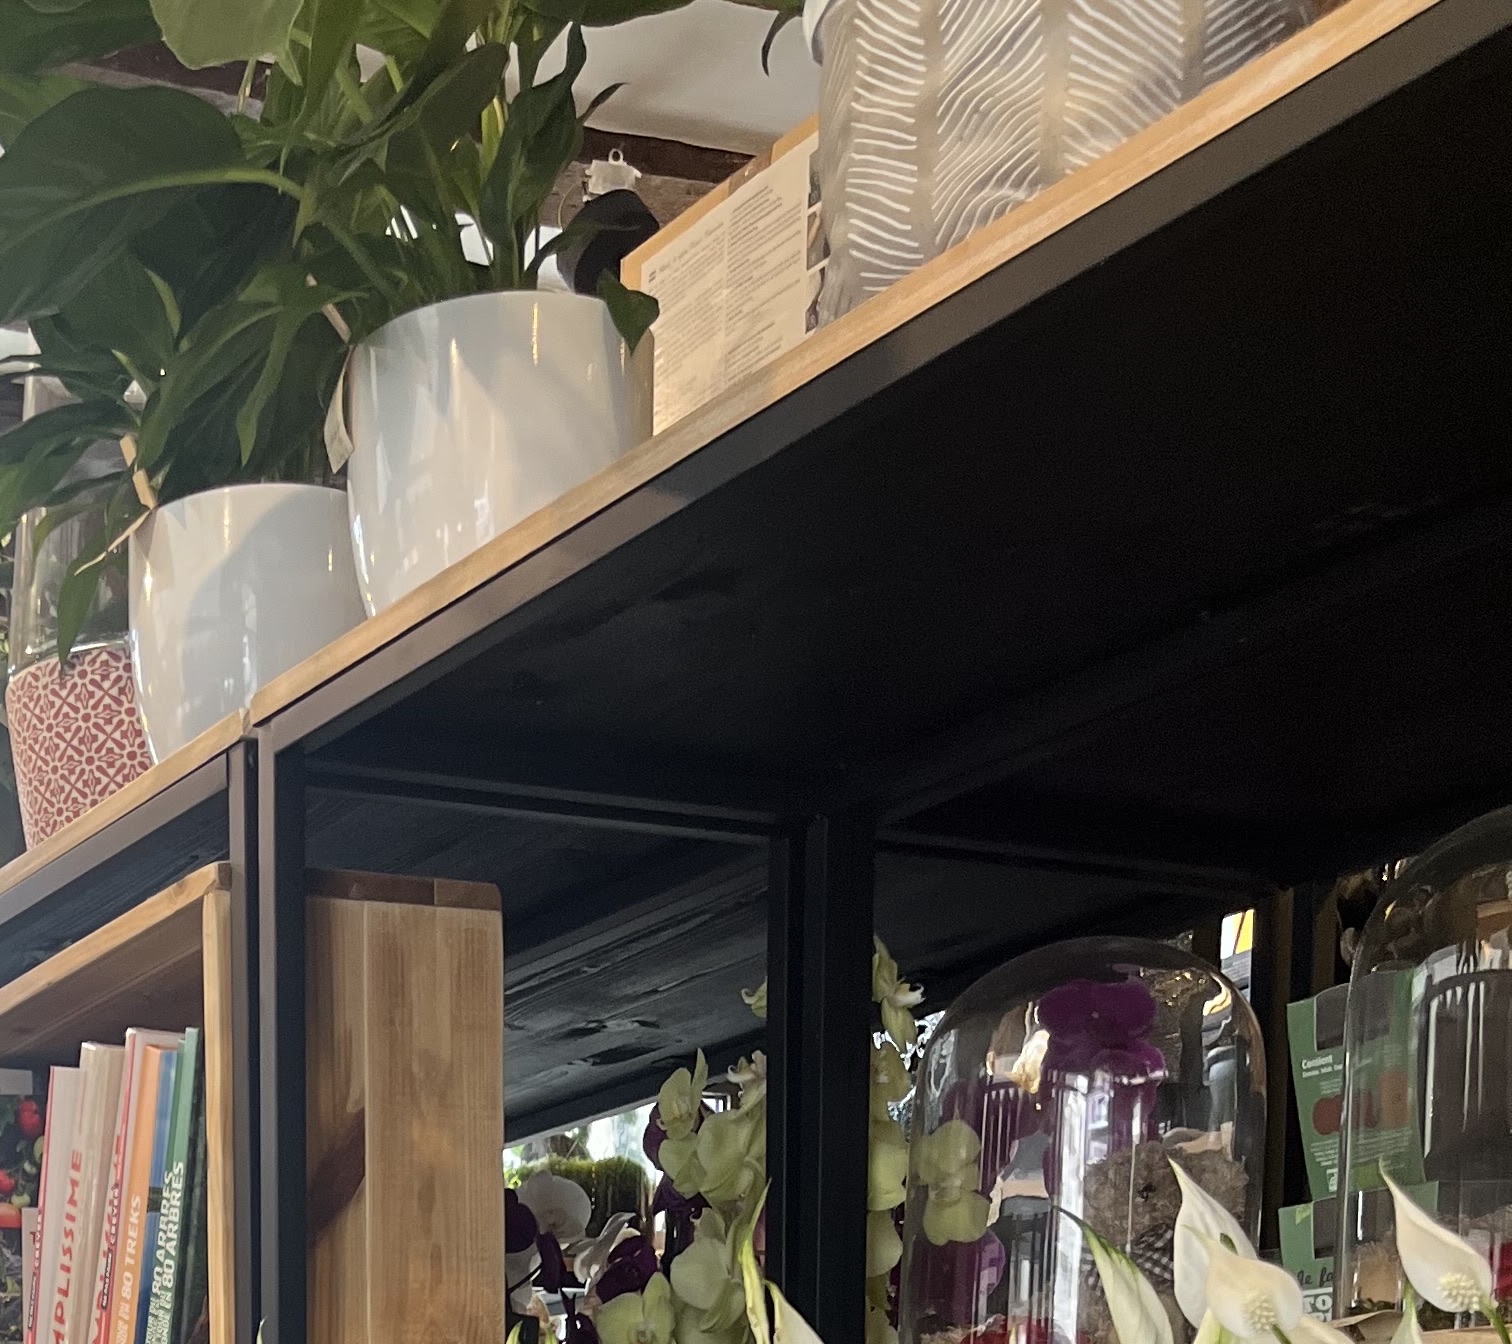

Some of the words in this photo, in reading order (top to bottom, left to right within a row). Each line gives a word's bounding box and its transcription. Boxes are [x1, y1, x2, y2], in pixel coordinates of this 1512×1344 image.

[1301, 1054, 1334, 1070] Contient
[166, 1160, 185, 1257] ARBRES
[125, 1195, 140, 1266] TREKS
[121, 1270, 134, 1300] 80
[162, 1258, 176, 1289] 80
